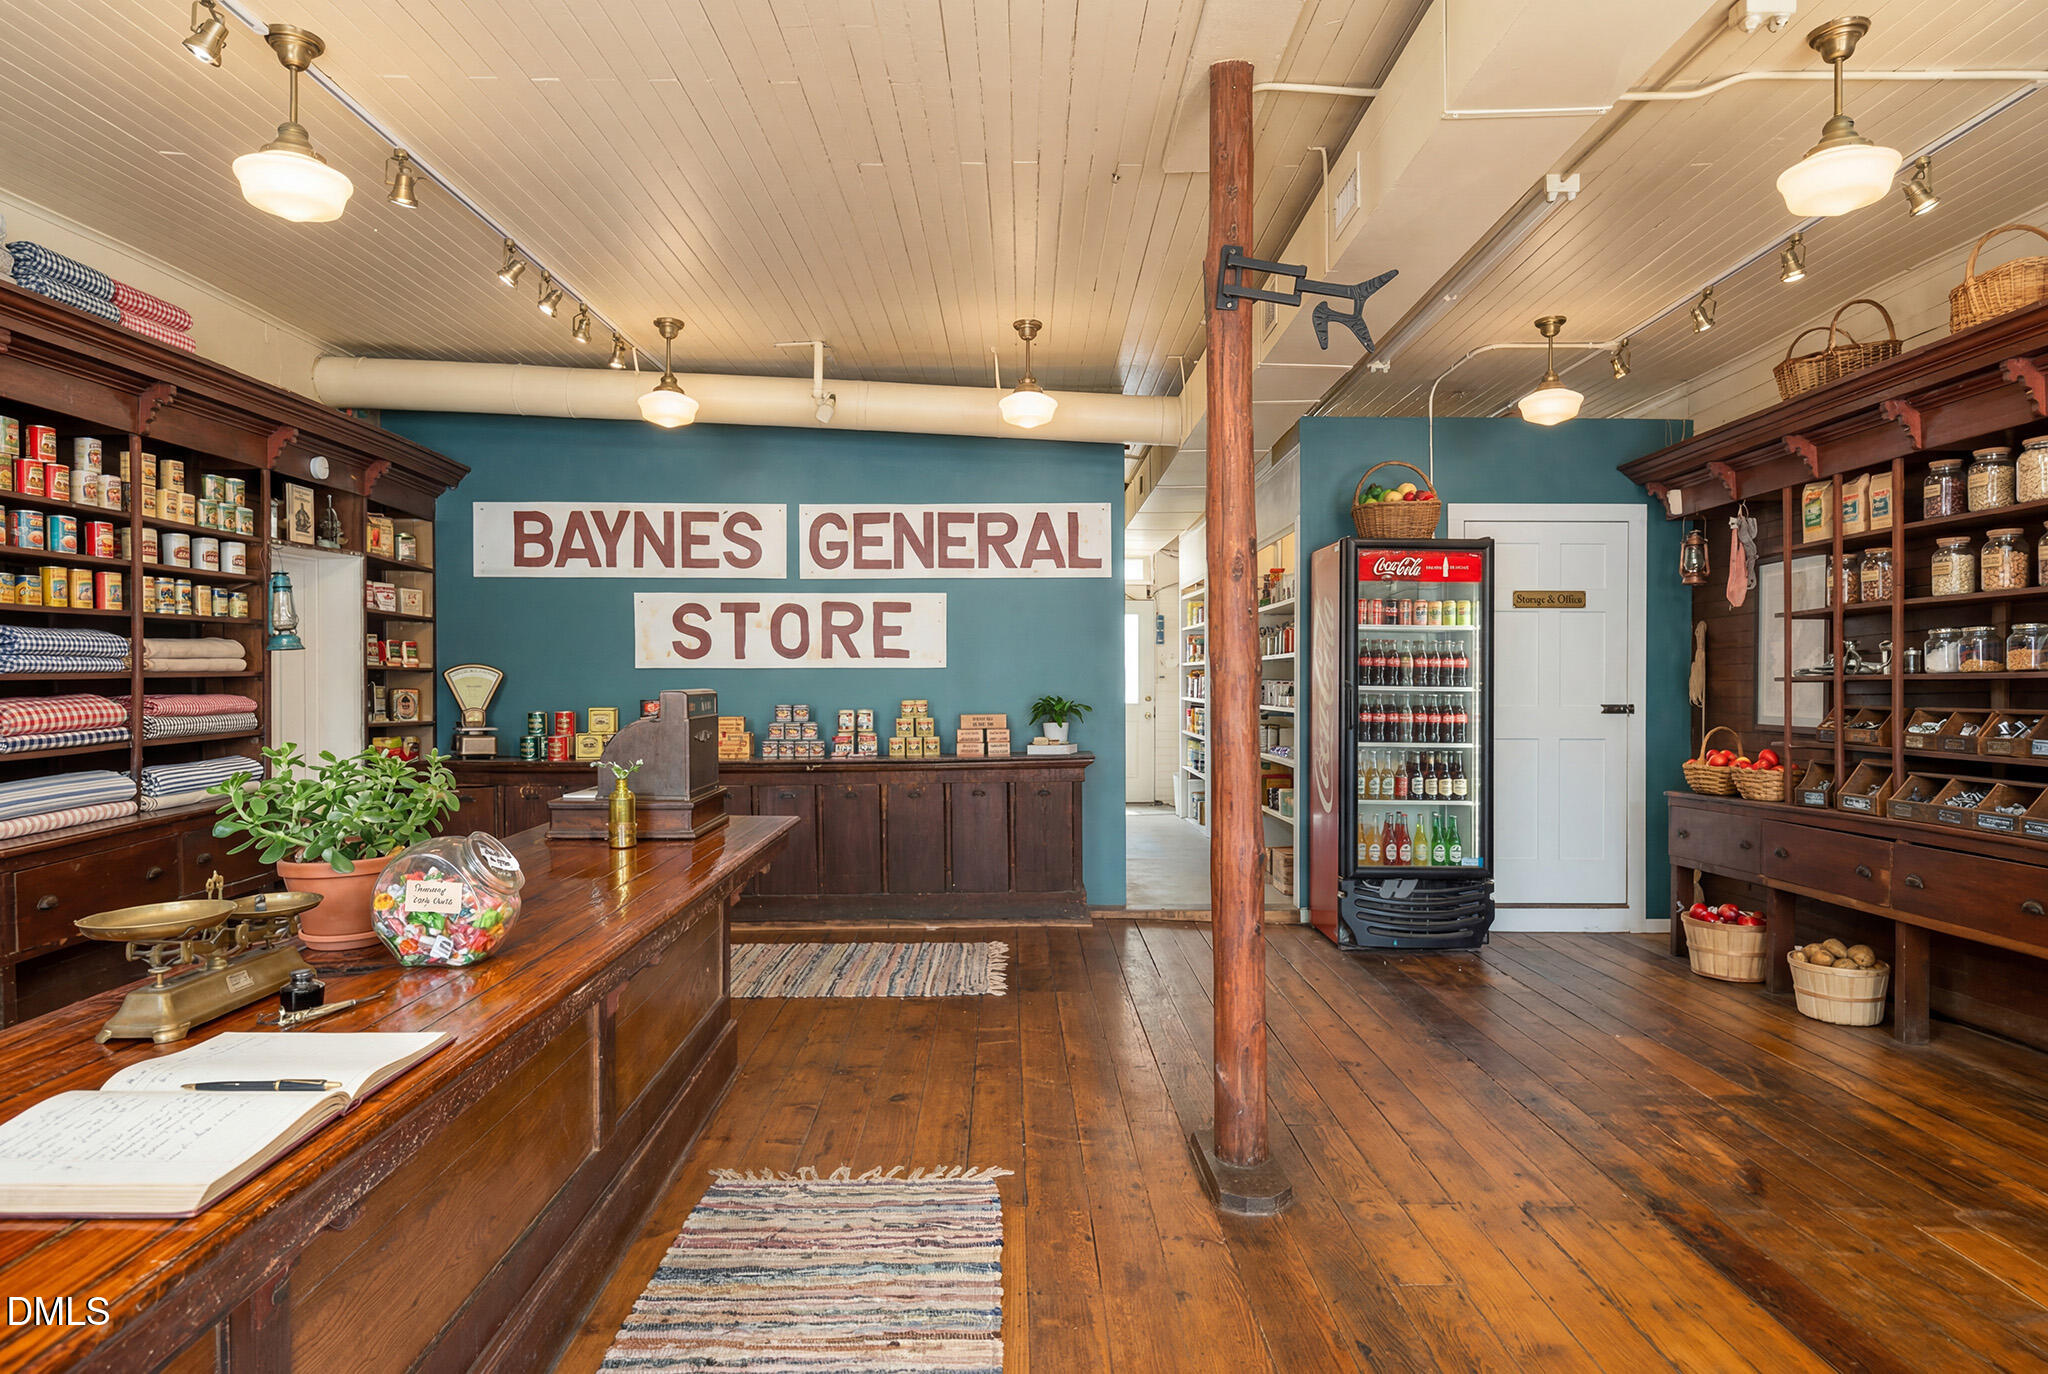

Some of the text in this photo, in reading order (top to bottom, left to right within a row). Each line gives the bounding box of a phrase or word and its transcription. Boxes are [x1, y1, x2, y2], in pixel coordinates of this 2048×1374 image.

[513, 510, 1103, 570] BAYNE'S GENERAL
[1547, 594, 1555, 604] &
[1557, 593, 1583, 604] Office
[671, 601, 912, 660] STORE
